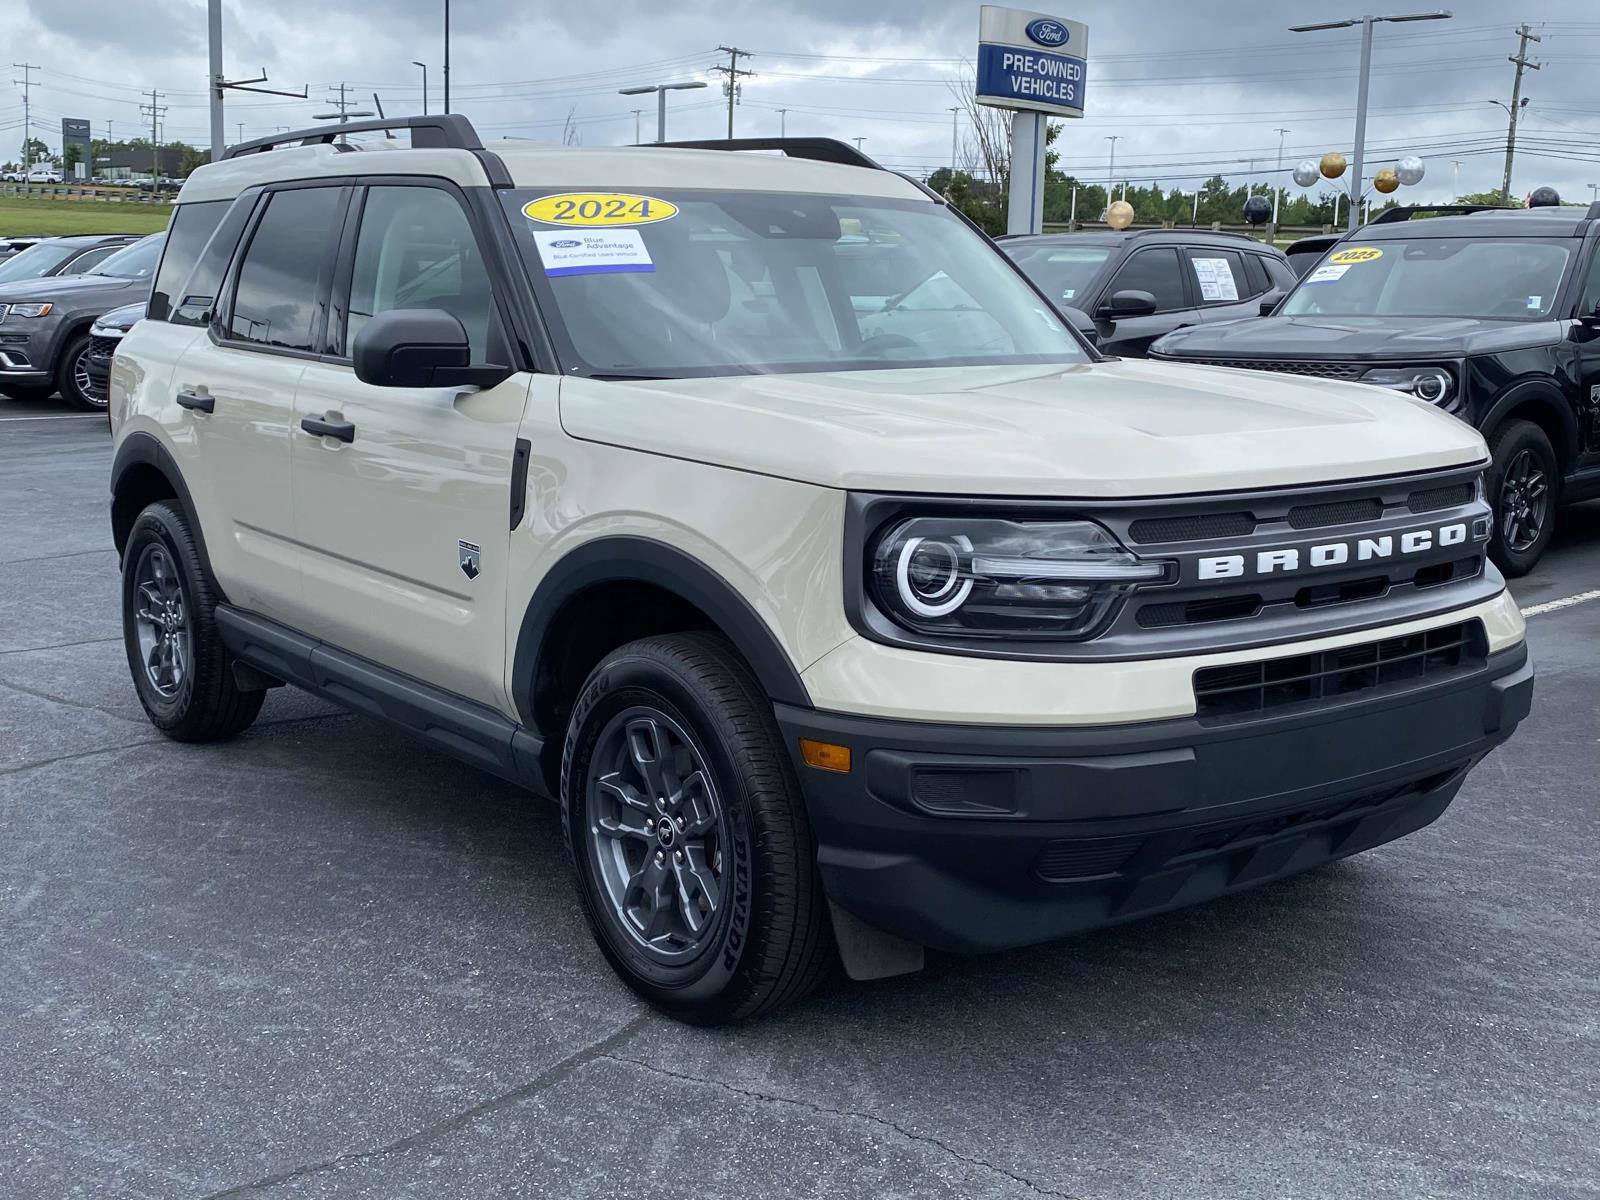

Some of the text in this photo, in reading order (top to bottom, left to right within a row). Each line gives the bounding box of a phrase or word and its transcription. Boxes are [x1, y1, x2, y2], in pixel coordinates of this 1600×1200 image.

[1039, 23, 1063, 41] Ford
[1002, 53, 1081, 81] PRE-OWNED
[1010, 75, 1075, 101] VEHICLES
[552, 199, 655, 221] 2024
[586, 242, 635, 250] Advantage
[1333, 250, 1379, 261] 2025
[1197, 523, 1467, 580] BRONCO
[723, 837, 749, 972] DUNLOP
